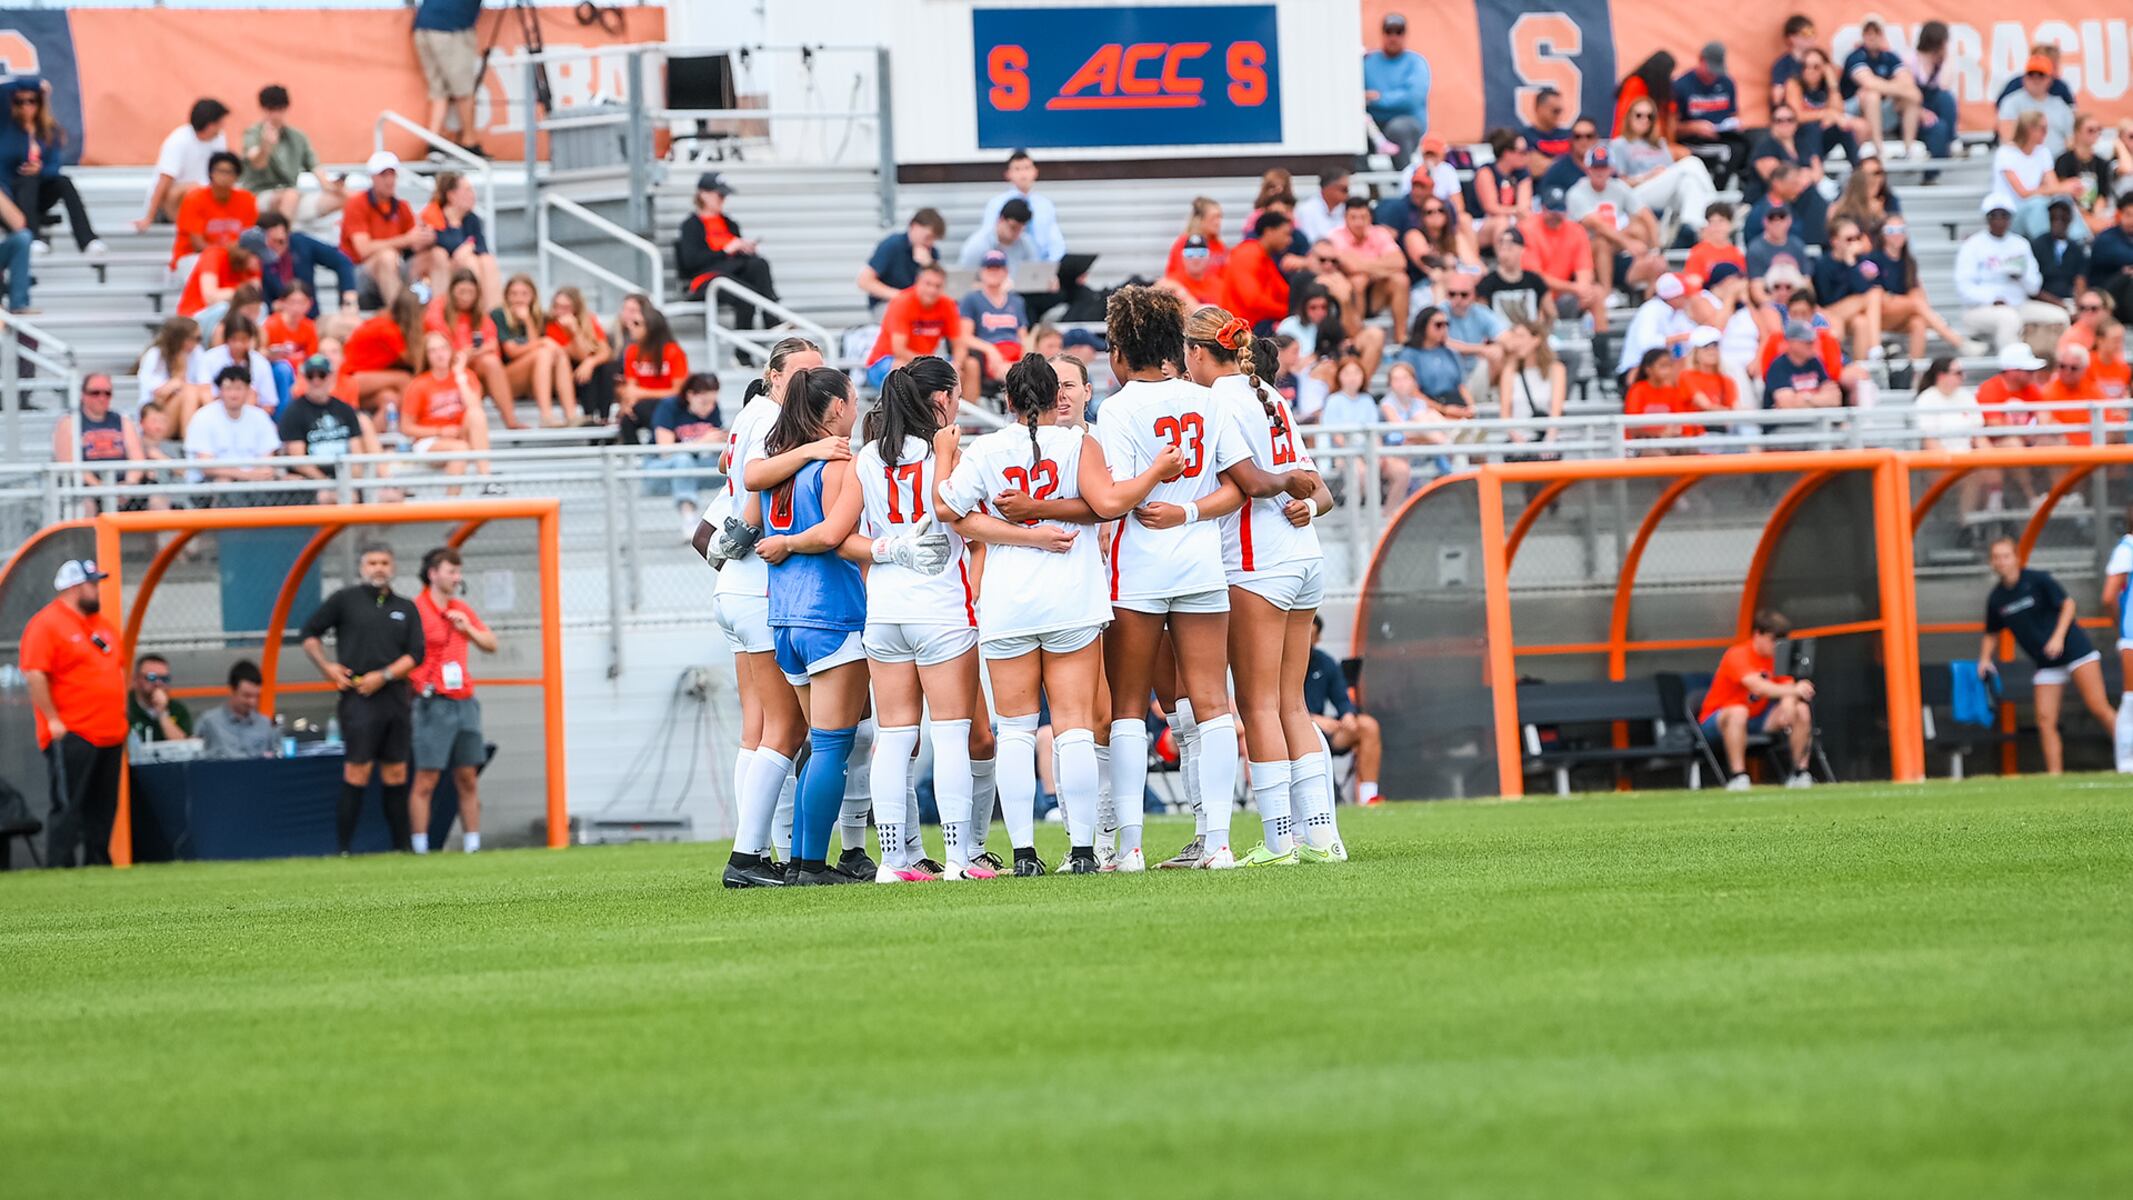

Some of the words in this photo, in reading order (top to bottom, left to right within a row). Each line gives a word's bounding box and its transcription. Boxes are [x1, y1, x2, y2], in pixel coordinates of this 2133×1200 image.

[987, 44, 1031, 112] S
[1059, 42, 1212, 96] ACC
[1226, 41, 1268, 107] S
[1508, 11, 1583, 130] S
[1153, 411, 1204, 484] 33
[883, 460, 927, 524] 17
